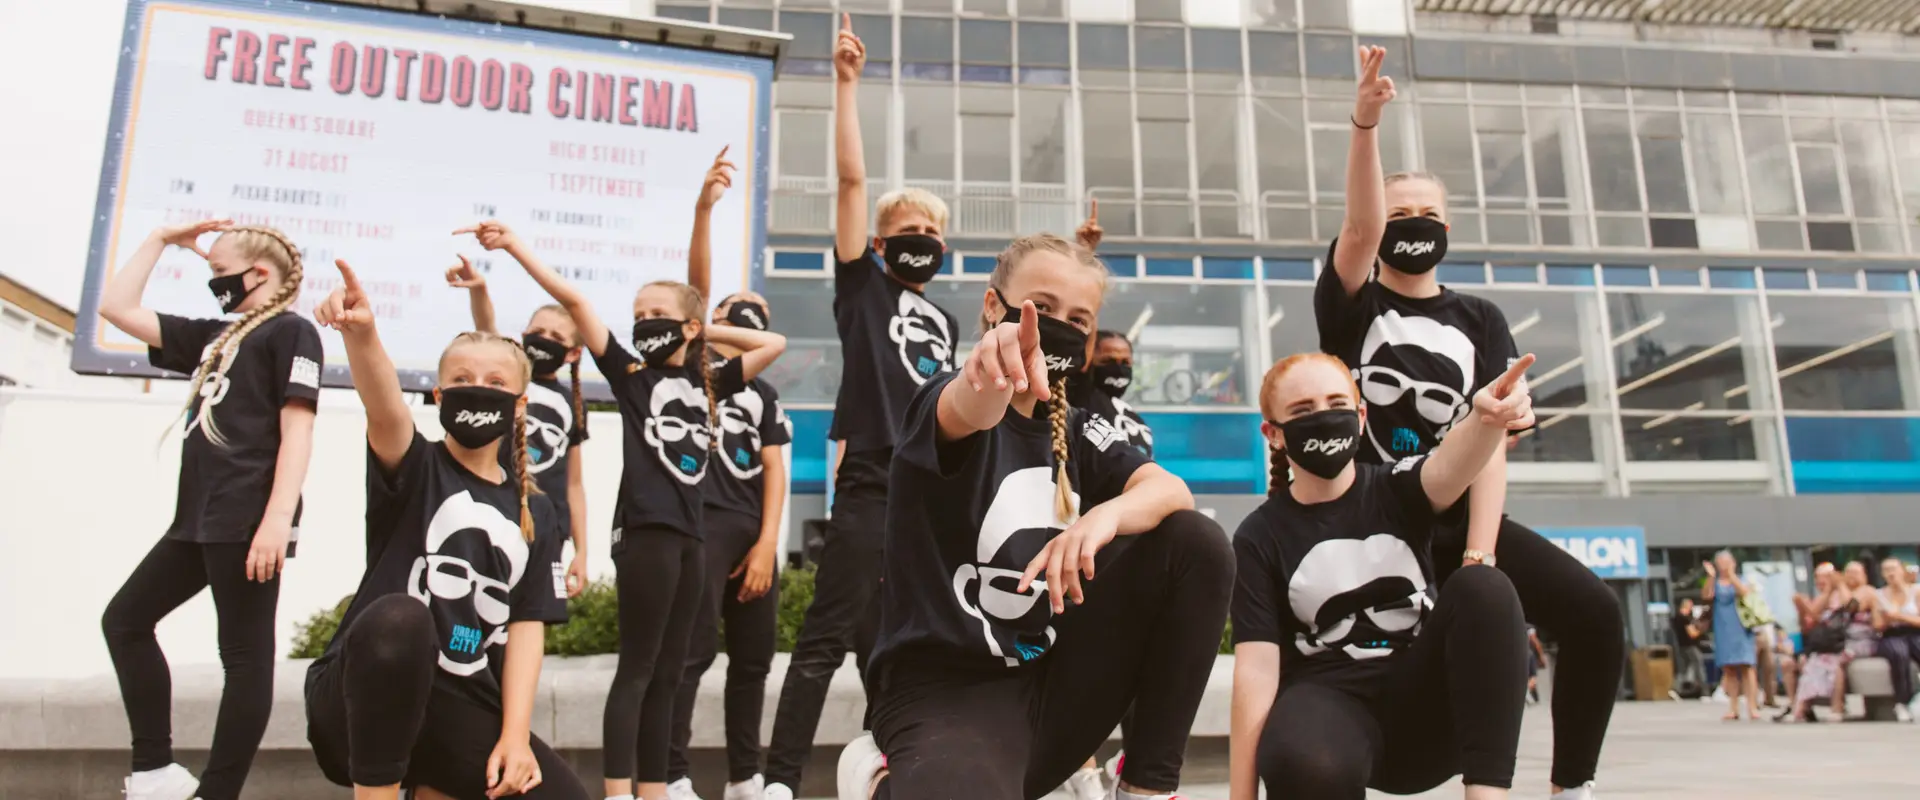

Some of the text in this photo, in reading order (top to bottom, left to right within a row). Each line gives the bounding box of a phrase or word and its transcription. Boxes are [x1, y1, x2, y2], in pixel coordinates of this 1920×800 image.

[204, 26, 699, 133] FREE OUTDOOR CINEMA
[243, 108, 377, 140] QUEENS SQUARE
[287, 149, 349, 174] AUGUST
[548, 140, 646, 167] HIGH STREET
[560, 173, 646, 199] SEPTEMBER
[1393, 240, 1435, 256] DVSN
[1044, 354, 1075, 371] SN
[455, 409, 504, 428] DVSN
[1303, 436, 1353, 455] DVSN
[453, 624, 482, 641] URBAN
[449, 636, 480, 654] CITY
